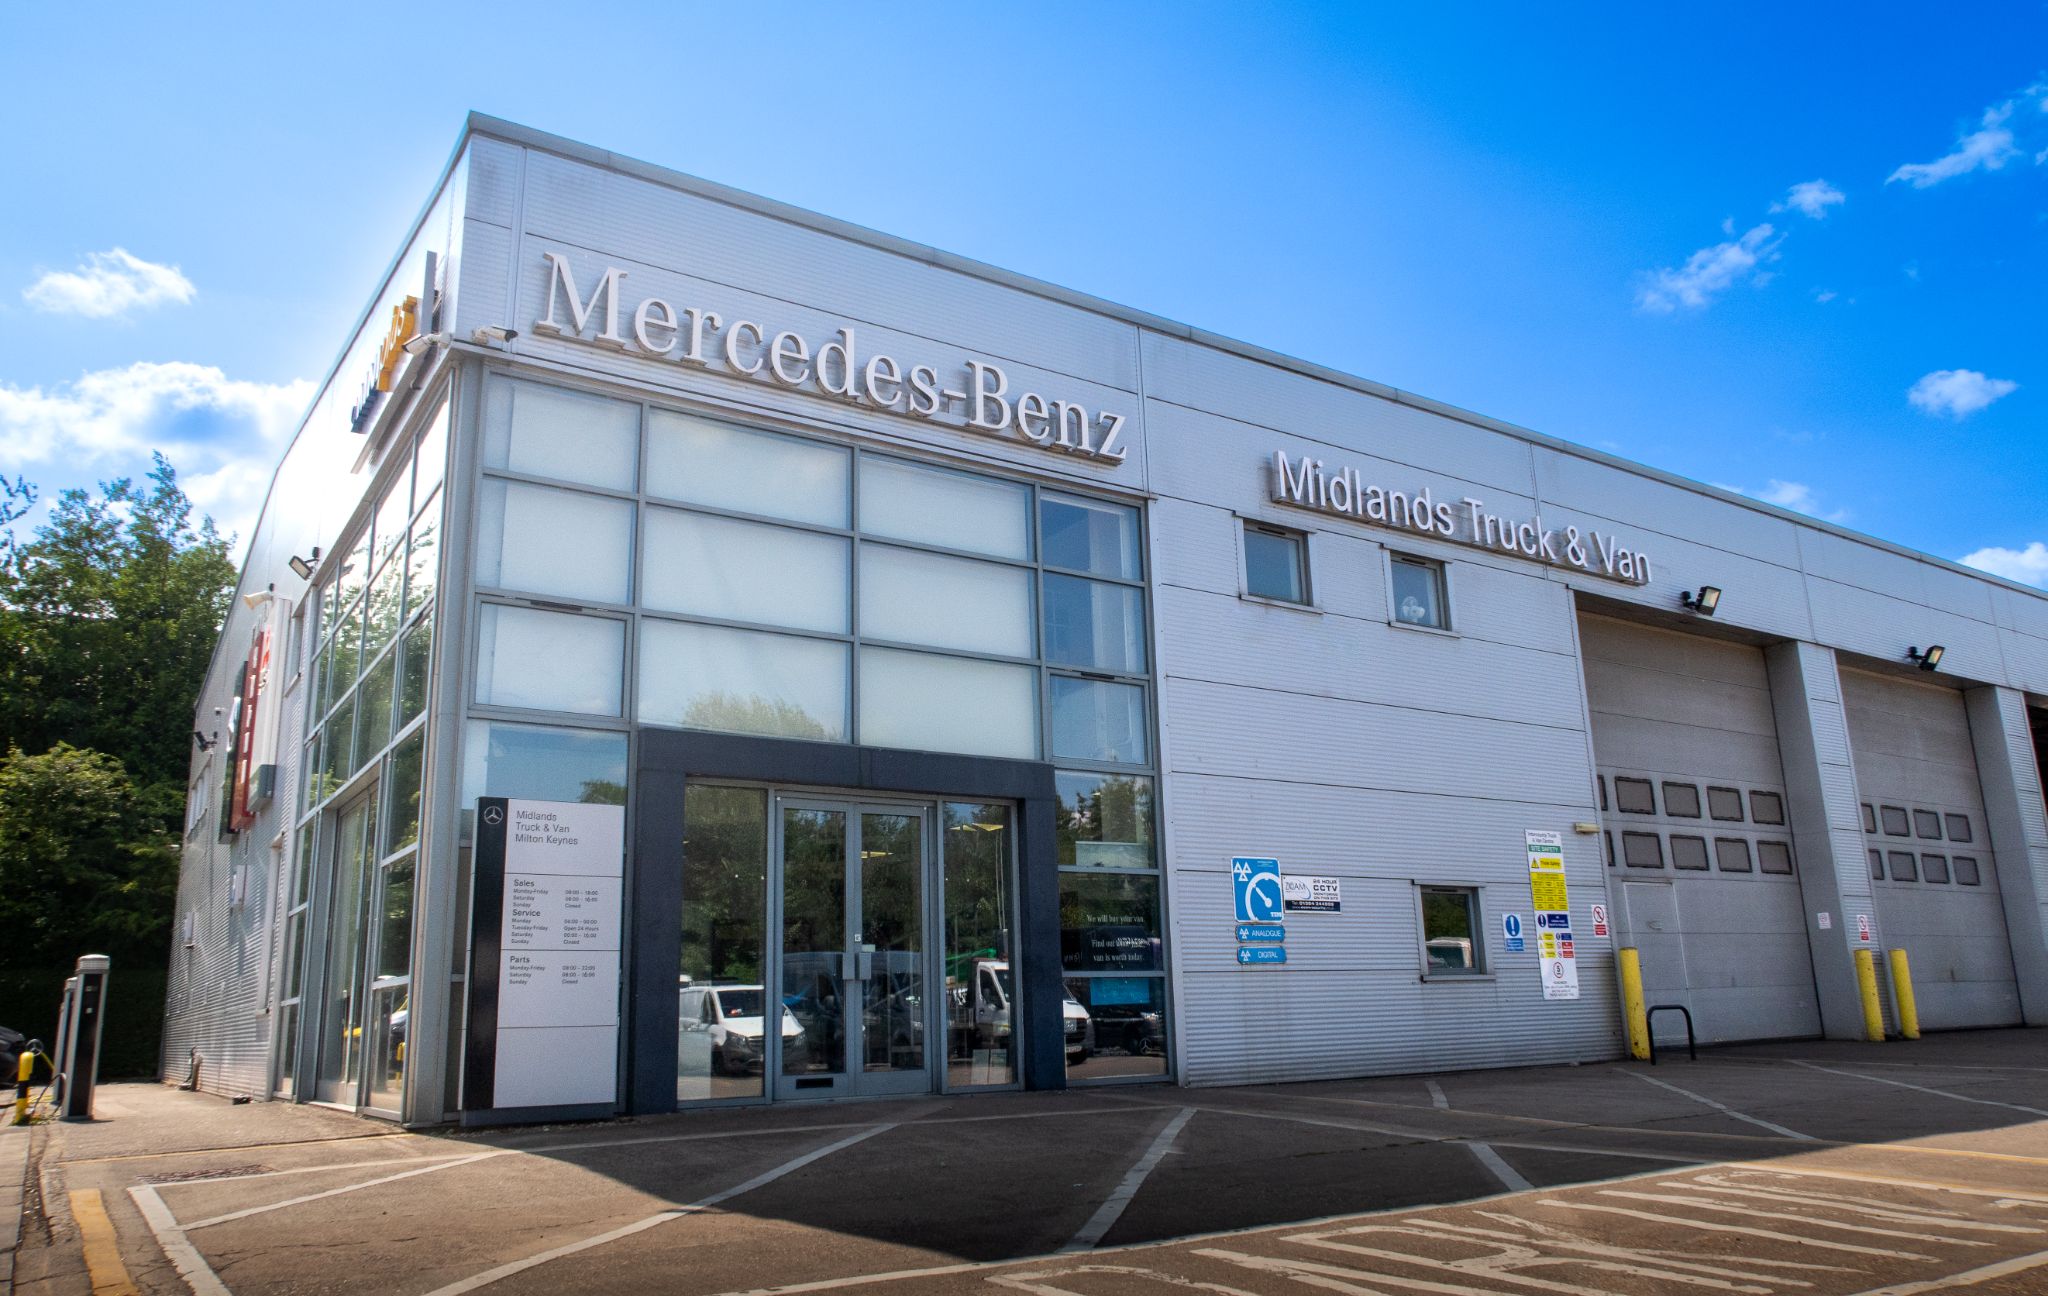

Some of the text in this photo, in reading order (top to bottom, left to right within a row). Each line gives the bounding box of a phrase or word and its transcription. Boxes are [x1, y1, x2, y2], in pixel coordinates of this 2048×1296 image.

[533, 251, 1128, 464] Mercedes-Benz
[1272, 450, 1652, 583] Midlands Truck & Van
[516, 810, 557, 821] Midlands
[515, 821, 570, 833] Truck & Van
[515, 833, 579, 846] Milton Keynes
[513, 879, 535, 887] Sales
[512, 909, 541, 917] Service
[1097, 914, 1108, 922] will
[1109, 914, 1119, 924] buy
[1091, 940, 1105, 948] Find
[1105, 940, 1115, 948] out
[510, 955, 530, 963] Parts
[1111, 952, 1126, 961] worth
